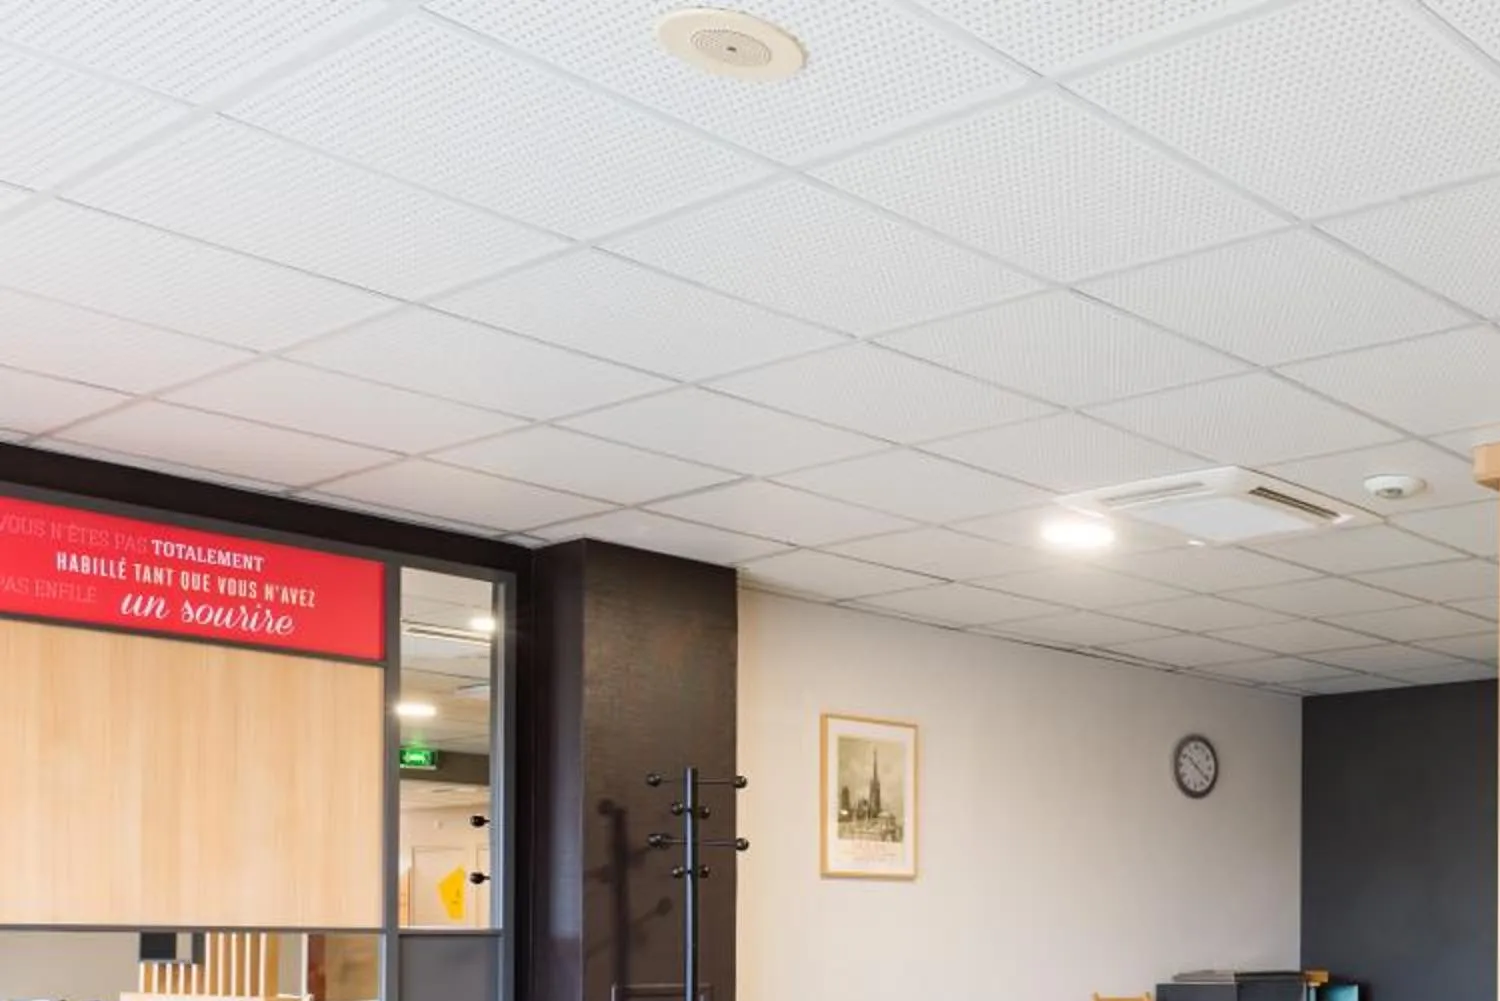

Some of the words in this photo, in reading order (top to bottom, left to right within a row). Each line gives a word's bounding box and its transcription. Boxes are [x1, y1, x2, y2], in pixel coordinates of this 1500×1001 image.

[114, 532, 148, 554] PAS
[151, 538, 265, 573] TOTALEMENT
[56, 551, 127, 581] HABILLÉ
[133, 563, 174, 587] TANT
[180, 570, 211, 593] QUE
[217, 575, 257, 600] VOUS
[264, 583, 316, 609] N'AVEZ
[119, 592, 171, 620] un
[180, 599, 296, 636] sourire
